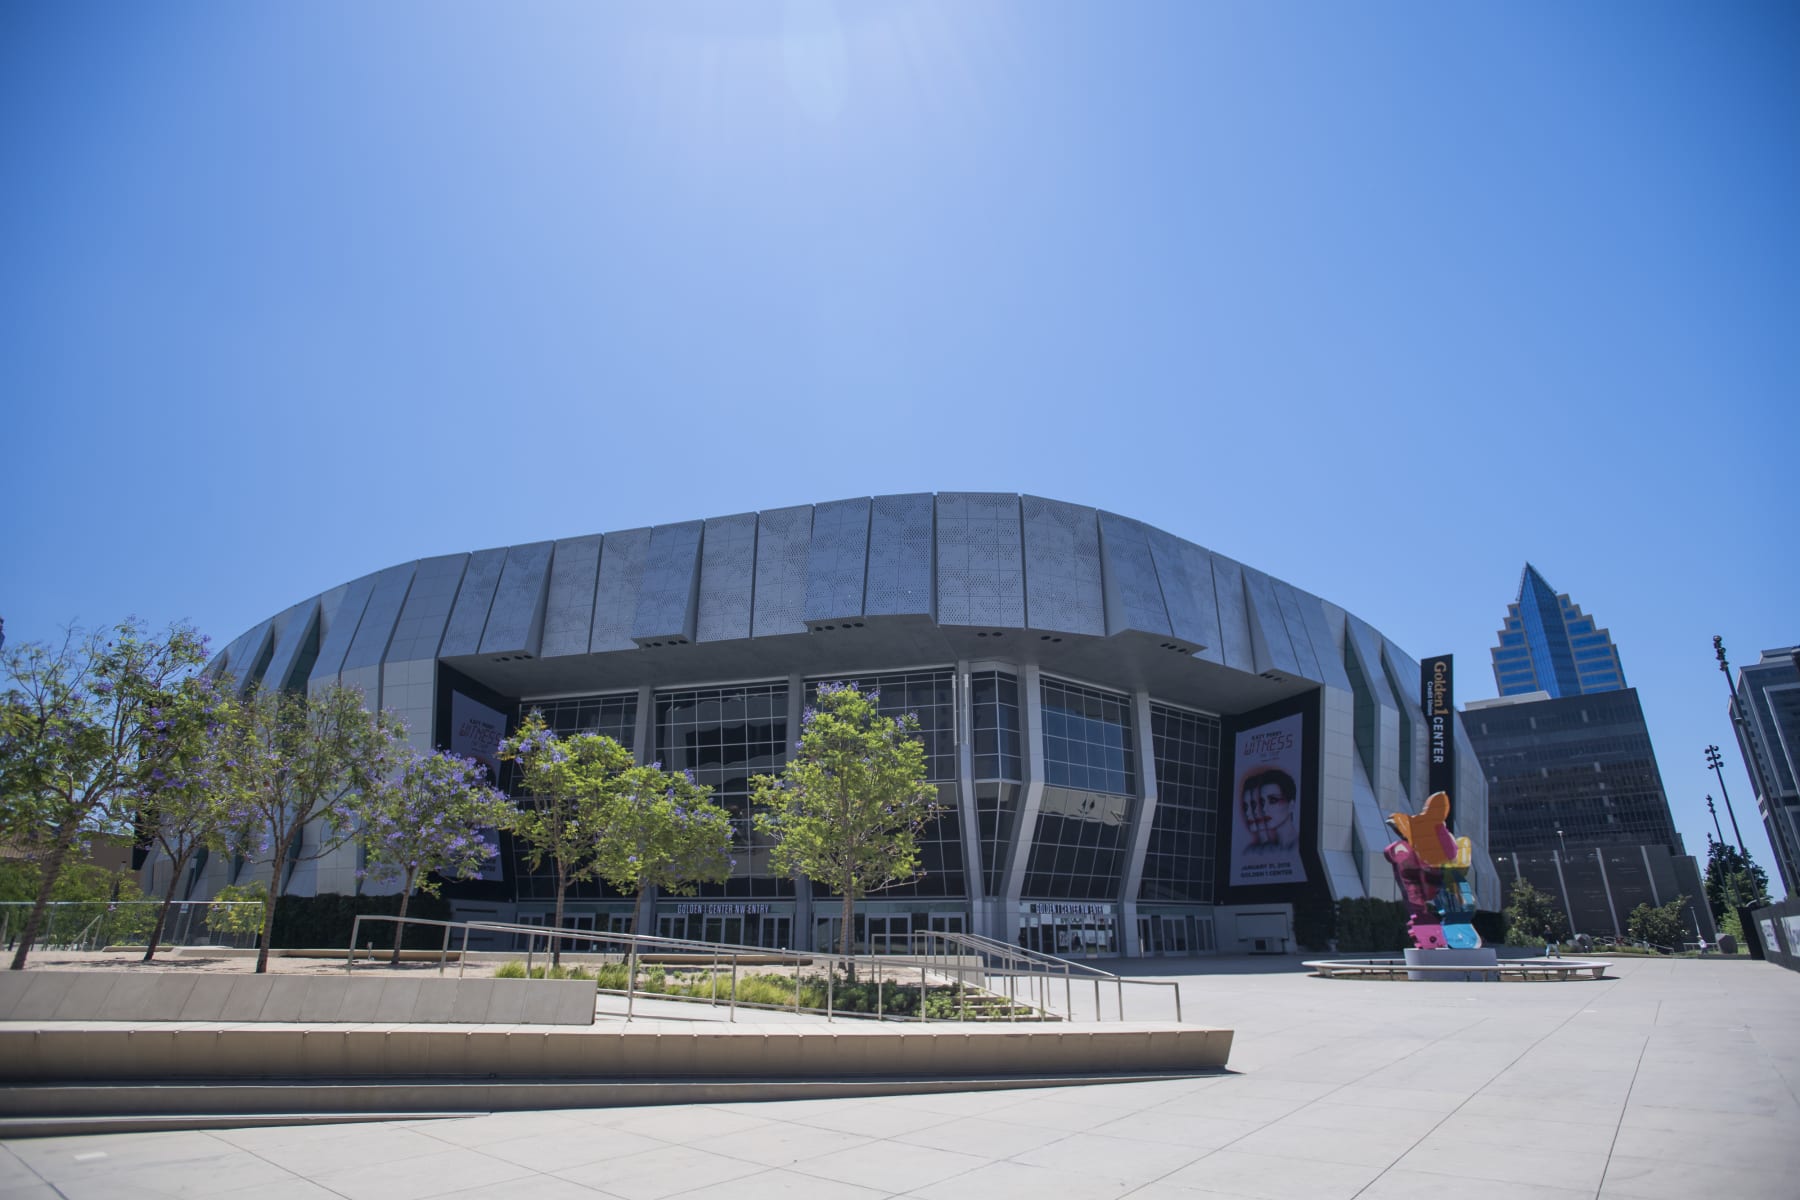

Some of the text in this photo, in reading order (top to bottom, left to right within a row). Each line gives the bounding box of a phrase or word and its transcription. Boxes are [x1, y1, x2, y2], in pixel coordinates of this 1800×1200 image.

[1434, 661, 1447, 707] Golden
[1243, 733, 1294, 755] WITNESS
[1433, 716, 1444, 763] CENTER
[677, 904, 702, 914] GOLDEN
[708, 904, 733, 914] CENTER
[735, 904, 745, 914] NW
[747, 904, 769, 914] ENTRY
